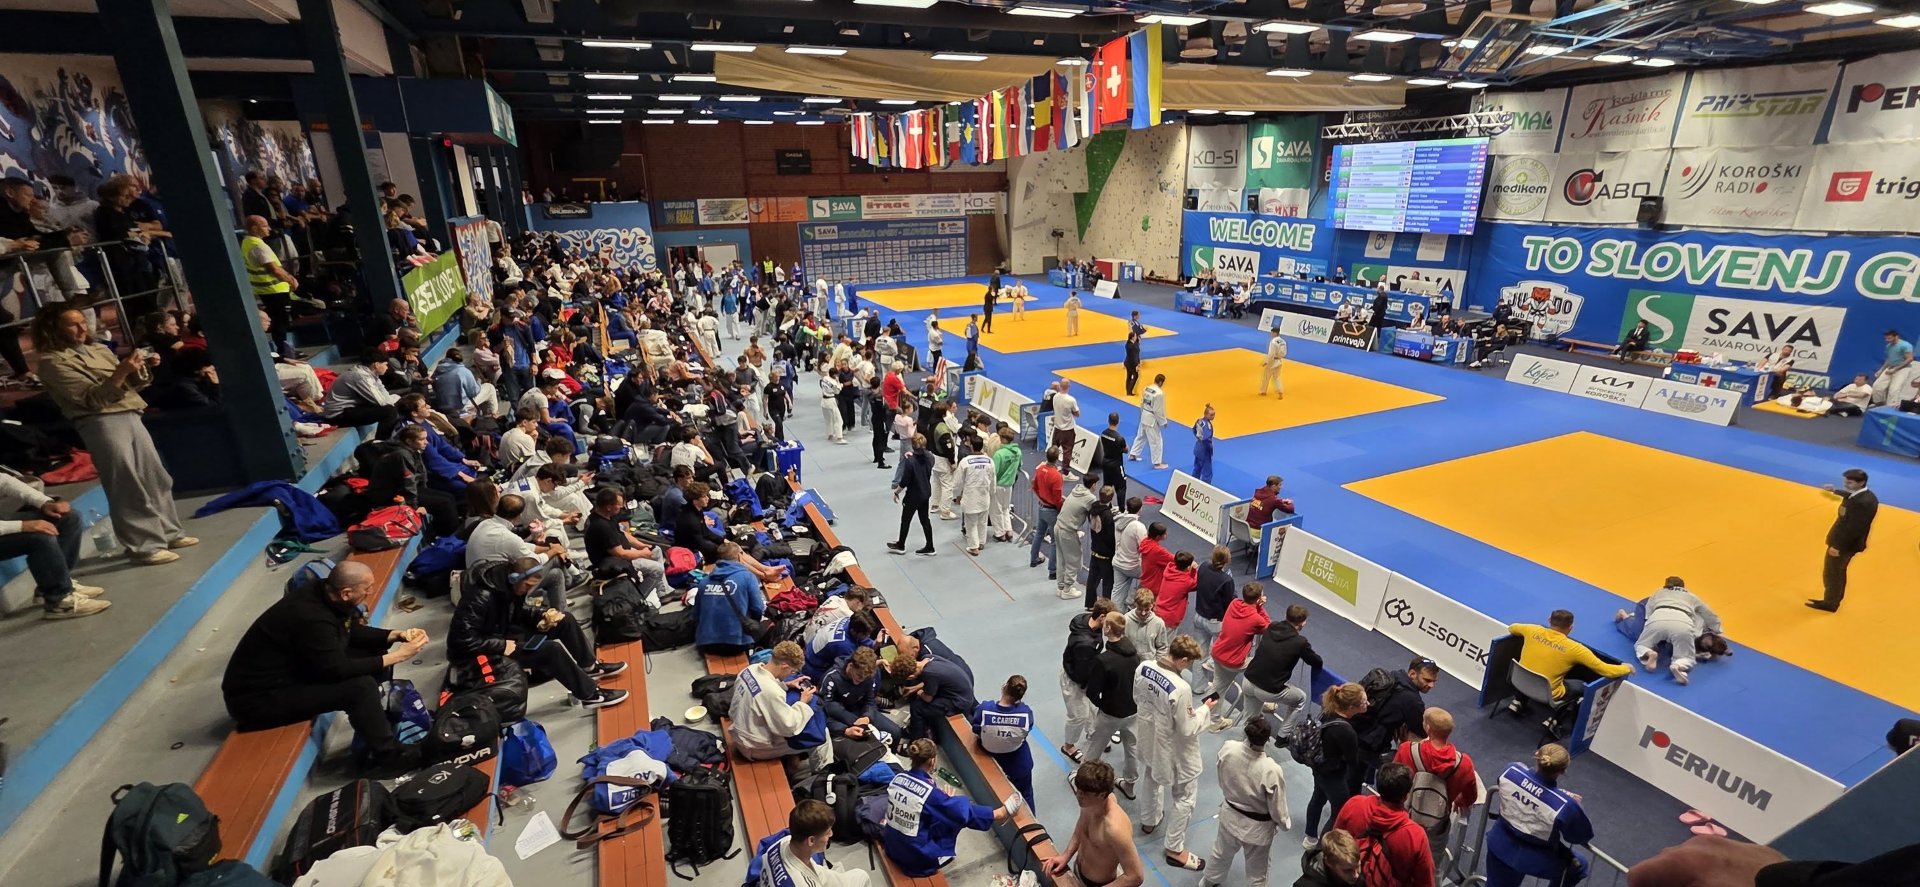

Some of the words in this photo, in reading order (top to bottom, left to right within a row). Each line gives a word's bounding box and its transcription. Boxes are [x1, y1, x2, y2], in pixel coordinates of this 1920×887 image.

[1193, 149, 1239, 165] KO-SI
[1276, 141, 1313, 157] SAVA
[1718, 163, 1801, 178] KOROŠKI
[1493, 184, 1547, 194] medikem
[831, 201, 856, 211] SAVA
[1210, 218, 1314, 250] WELCOME
[1218, 254, 1254, 274] SAVA
[1524, 235, 1582, 275] TO
[1586, 238, 1850, 294] SLOVENJ
[1704, 308, 1822, 347] SAVA
[1332, 335, 1366, 348] printvajb
[1404, 349, 1420, 358] 1:30
[1591, 374, 1635, 390] KIA
[1585, 390, 1627, 403] KOROŠKA
[1185, 482, 1210, 504] Lesna
[1191, 499, 1214, 523] Vrata
[1172, 511, 1215, 538] www.lesna-vrata.si
[1313, 556, 1335, 573] FEEL
[1303, 563, 1349, 591] SLOVENIA
[1418, 617, 1491, 667] LESOTEK
[1148, 684, 1160, 697] SUI
[997, 730, 1012, 738] ITA
[1638, 724, 1773, 811] PERIUM
[1521, 777, 1544, 798] BAYR
[895, 792, 908, 805] ITA
[1511, 791, 1540, 810] AUT
[895, 807, 916, 821] BORN
